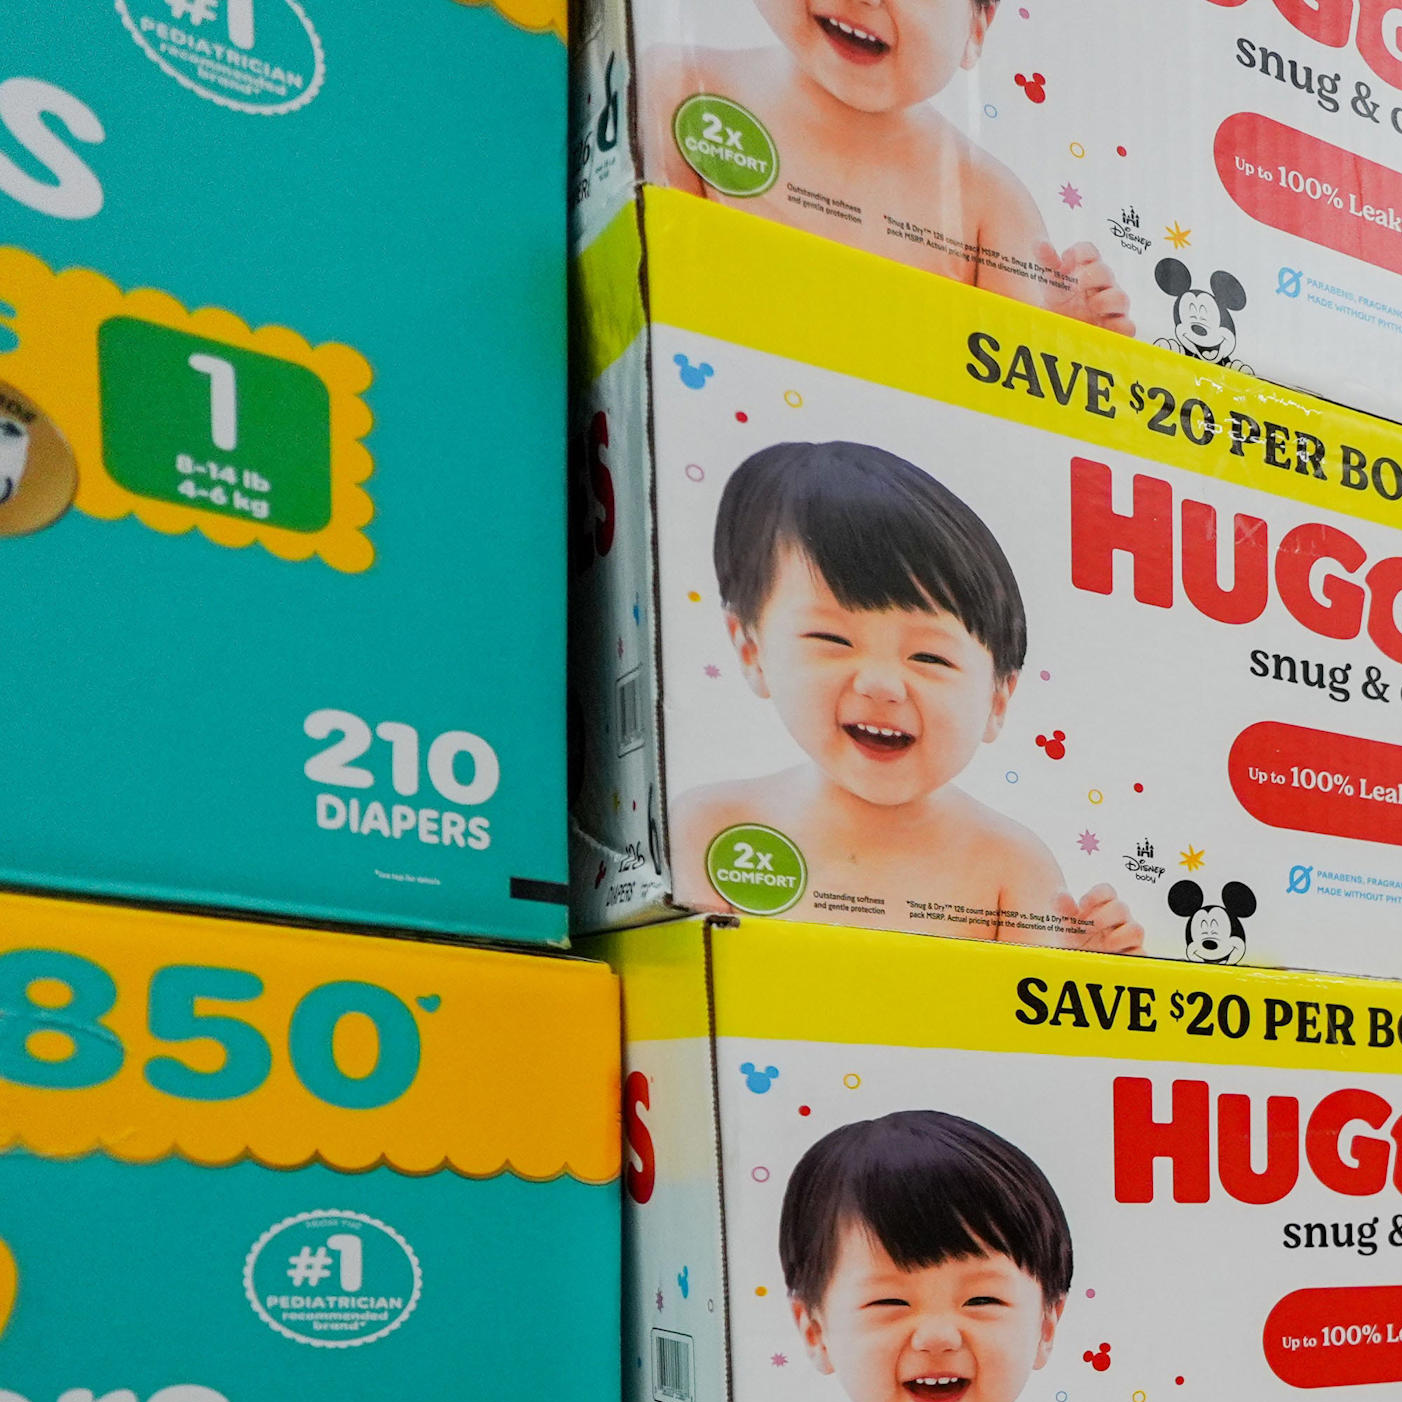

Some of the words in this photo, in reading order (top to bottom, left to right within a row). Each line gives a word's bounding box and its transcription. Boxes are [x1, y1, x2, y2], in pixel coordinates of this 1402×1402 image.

[139, 16, 304, 89] PEDIATRICIAN
[157, 41, 289, 97] recommended
[1236, 37, 1341, 113] snug
[1351, 83, 1382, 124] &
[685, 136, 768, 174] COMFORT
[1234, 156, 1255, 177] Up
[1257, 164, 1274, 183] to
[1277, 165, 1344, 209] 100%
[188, 353, 238, 451] 1
[965, 330, 1117, 421] SAVE
[1129, 379, 1216, 447] $20
[1228, 410, 1328, 483] PER
[1249, 648, 1352, 703] snug
[1361, 666, 1392, 703] &
[303, 708, 500, 806] 210
[1248, 766, 1268, 786] Up
[1270, 771, 1286, 785] to
[1290, 766, 1355, 797] 100%
[315, 794, 491, 850] DIAPERS
[732, 842, 775, 871] 2x
[716, 866, 798, 890] COMFORT
[813, 890, 855, 904] Outstanding
[857, 896, 885, 905] softness
[1135, 872, 1157, 884] baby
[1344, 890, 1384, 901] WITHOUT
[814, 901, 827, 910] and
[828, 902, 850, 912] gentle
[851, 905, 886, 915] protection
[1015, 976, 1158, 1033] SAVE
[1169, 990, 1252, 1040] $20
[1263, 1001, 1356, 1047] PER
[1282, 1217, 1378, 1257] snug
[287, 1234, 365, 1292] #1
[266, 1295, 403, 1310] PEDIATRICIAN
[282, 1310, 388, 1322] recommended
[1282, 1335, 1301, 1351] Up
[1303, 1335, 1317, 1348] to
[1321, 1325, 1382, 1347] 100%
